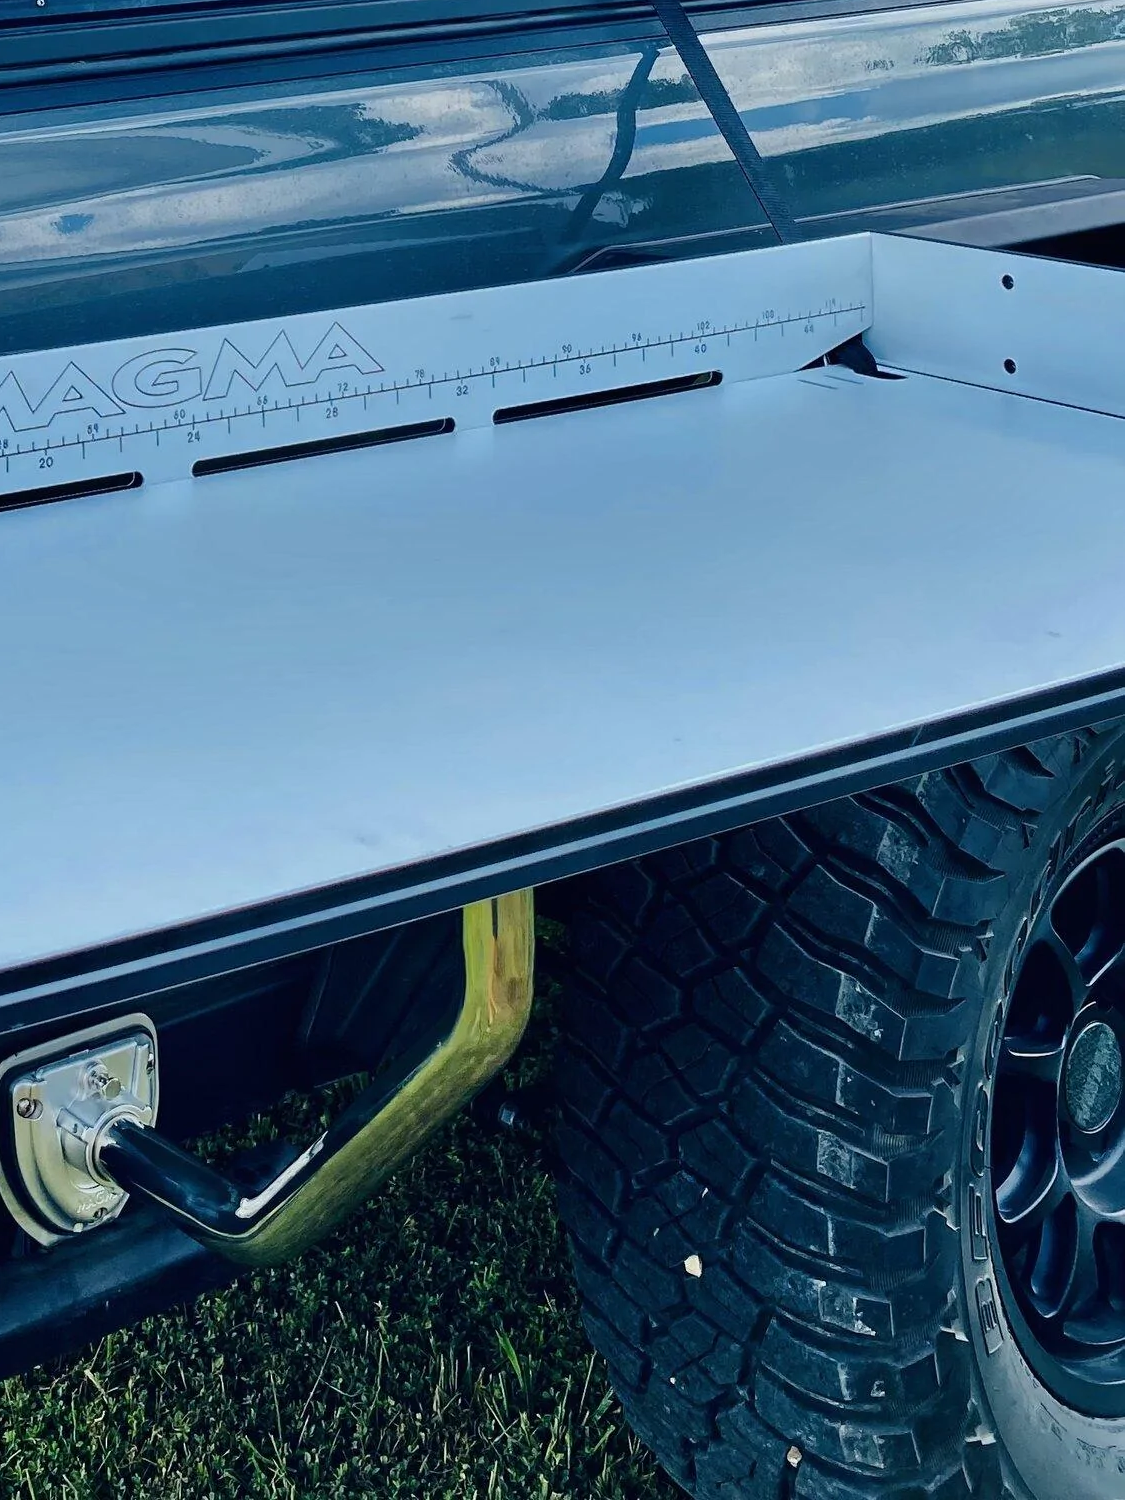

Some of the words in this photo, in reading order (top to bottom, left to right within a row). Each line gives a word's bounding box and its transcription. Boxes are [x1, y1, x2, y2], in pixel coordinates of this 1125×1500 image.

[39, 457, 54, 469] 20
[187, 431, 201, 443] 24
[326, 407, 339, 418] 28
[456, 385, 469, 396] 32
[579, 364, 592, 375] 36
[338, 382, 349, 393] 72
